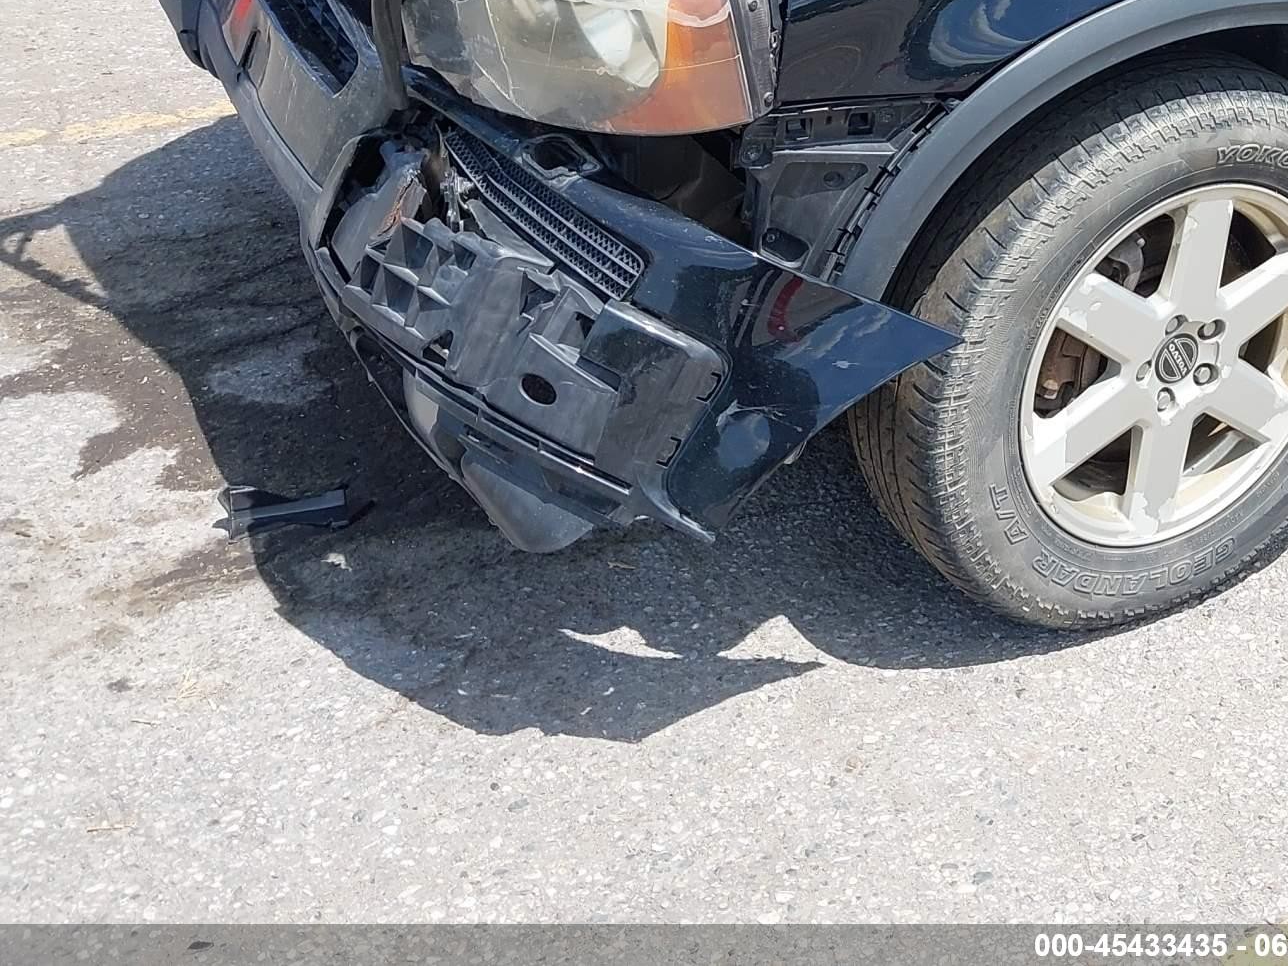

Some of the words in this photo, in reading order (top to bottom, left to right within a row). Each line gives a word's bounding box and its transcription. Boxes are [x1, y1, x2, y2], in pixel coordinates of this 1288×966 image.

[1168, 343, 1188, 376] VOLVO
[989, 483, 1029, 545] A/T
[1031, 537, 1236, 596] GEOLANDAR
